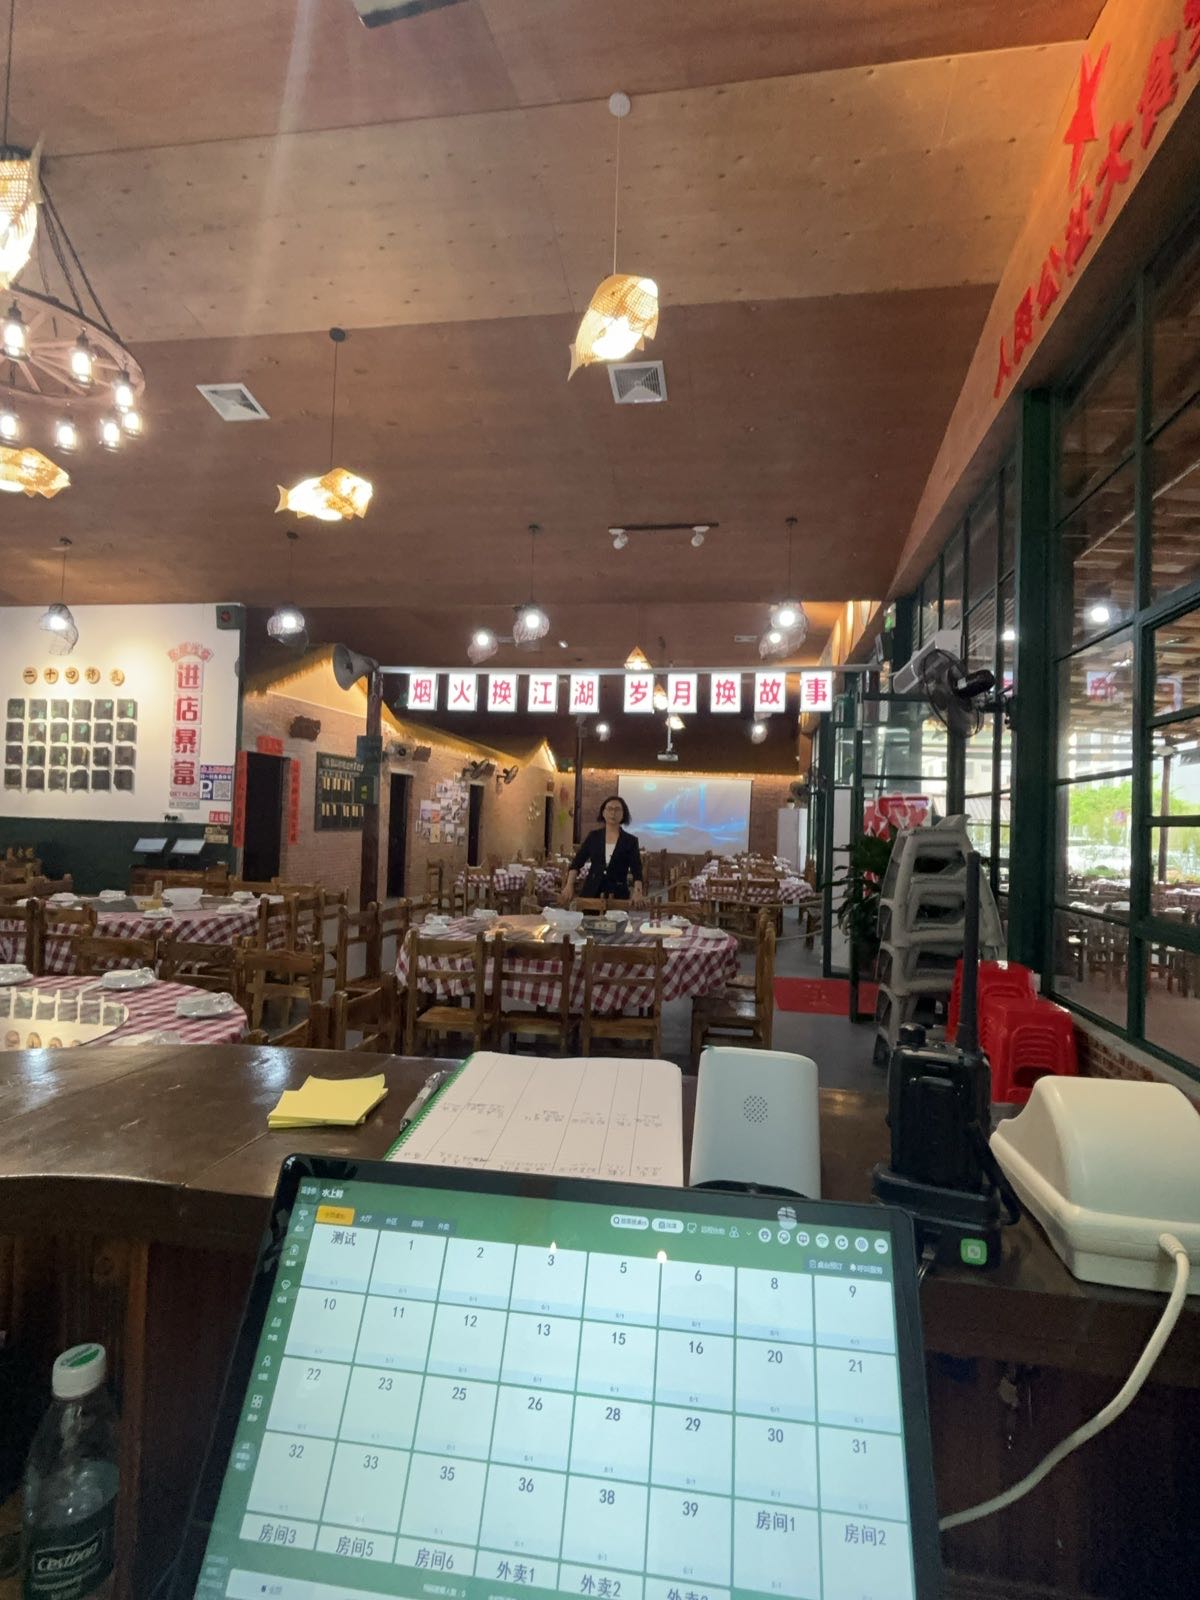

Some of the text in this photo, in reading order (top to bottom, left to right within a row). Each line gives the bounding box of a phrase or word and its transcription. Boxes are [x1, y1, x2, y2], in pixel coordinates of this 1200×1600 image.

[173, 664, 200, 785] 进店暴富
[412, 677, 828, 706] 烟火换江湖 岁月换故事
[330, 1230, 357, 1246] 测试
[408, 1239, 857, 1298] 1 2 3 5 6 8 9
[323, 1297, 864, 1372] 10 11 12 13 15 16 20 21
[306, 1367, 868, 1453] 22 23 25 26 28 29 30 31
[288, 1444, 699, 1518] 32 33 35 36 38 39
[258, 1523, 621, 1597] 房间3 房间5 房间6 外卖1 外卖2
[756, 1510, 887, 1546] 房间1 房间2
